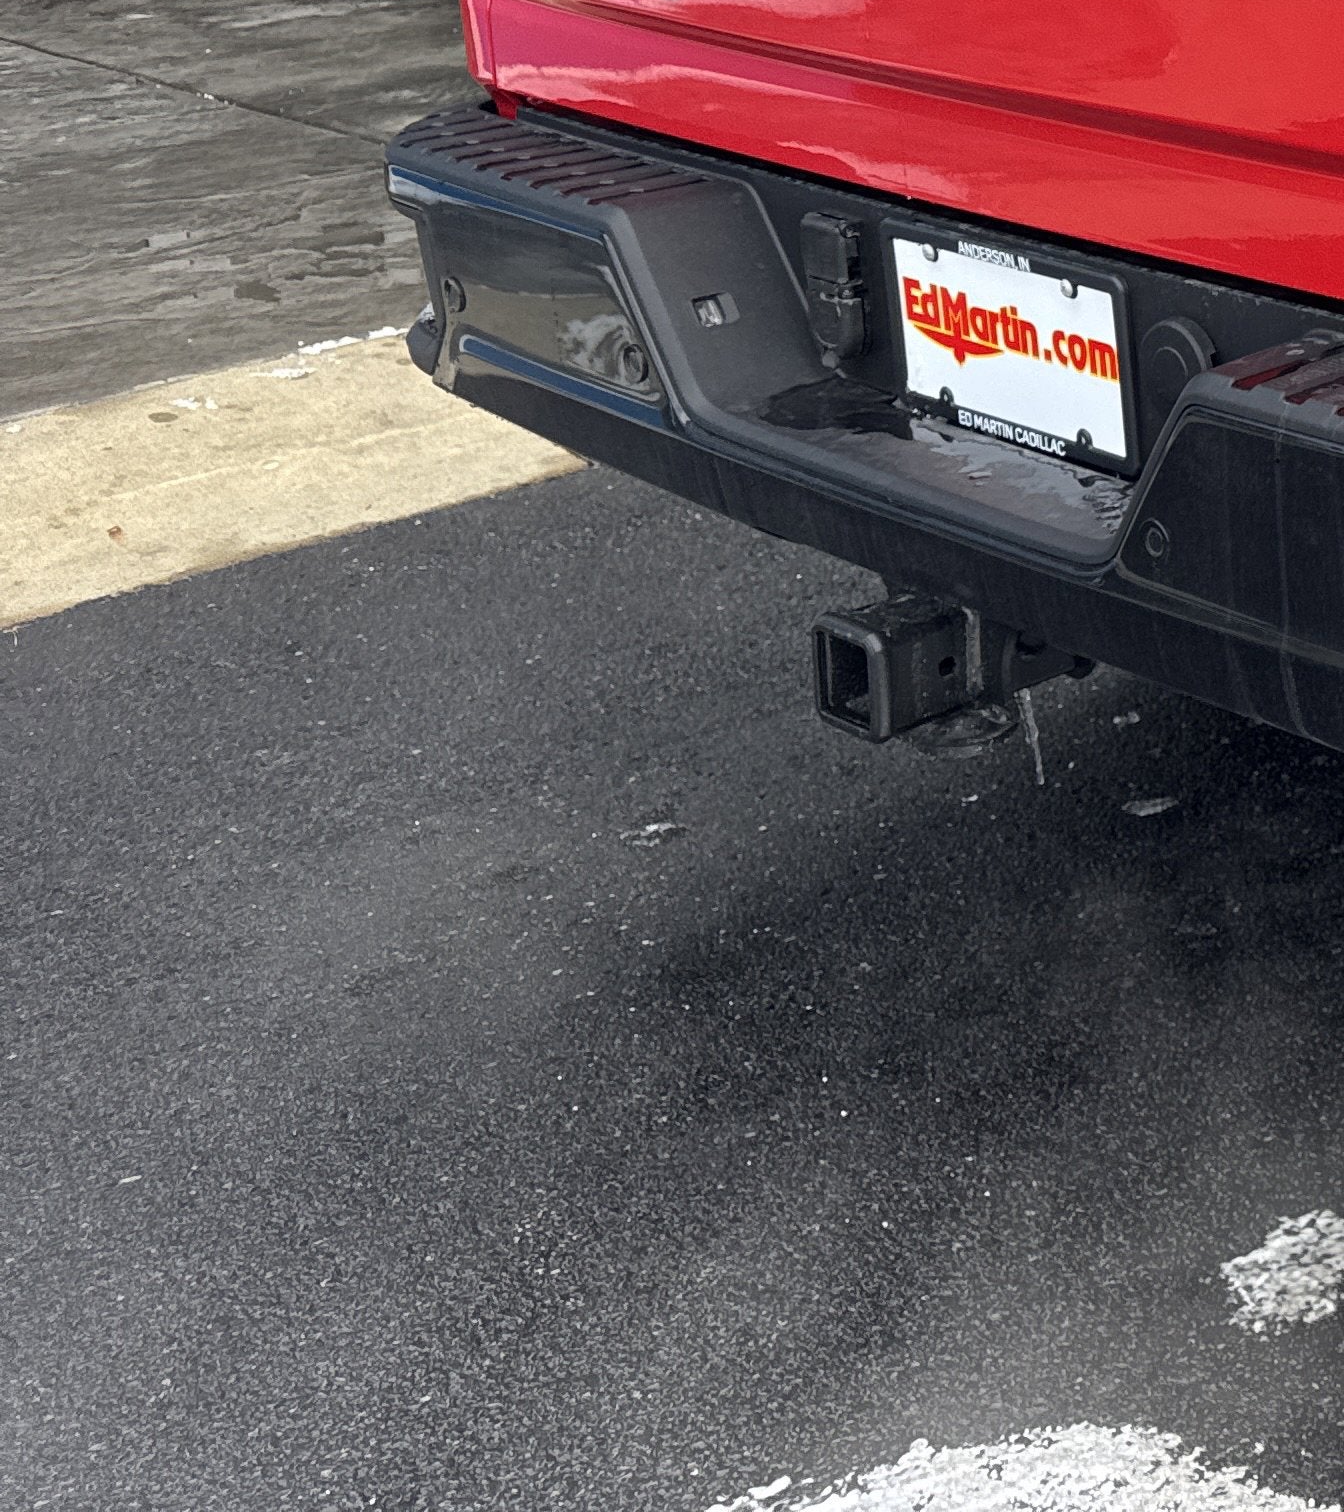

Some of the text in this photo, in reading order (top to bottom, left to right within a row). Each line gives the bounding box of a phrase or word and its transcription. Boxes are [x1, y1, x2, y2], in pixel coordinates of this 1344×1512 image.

[1017, 255, 1031, 273] IN
[957, 409, 1067, 457] ED MARTIN CADILLAC
